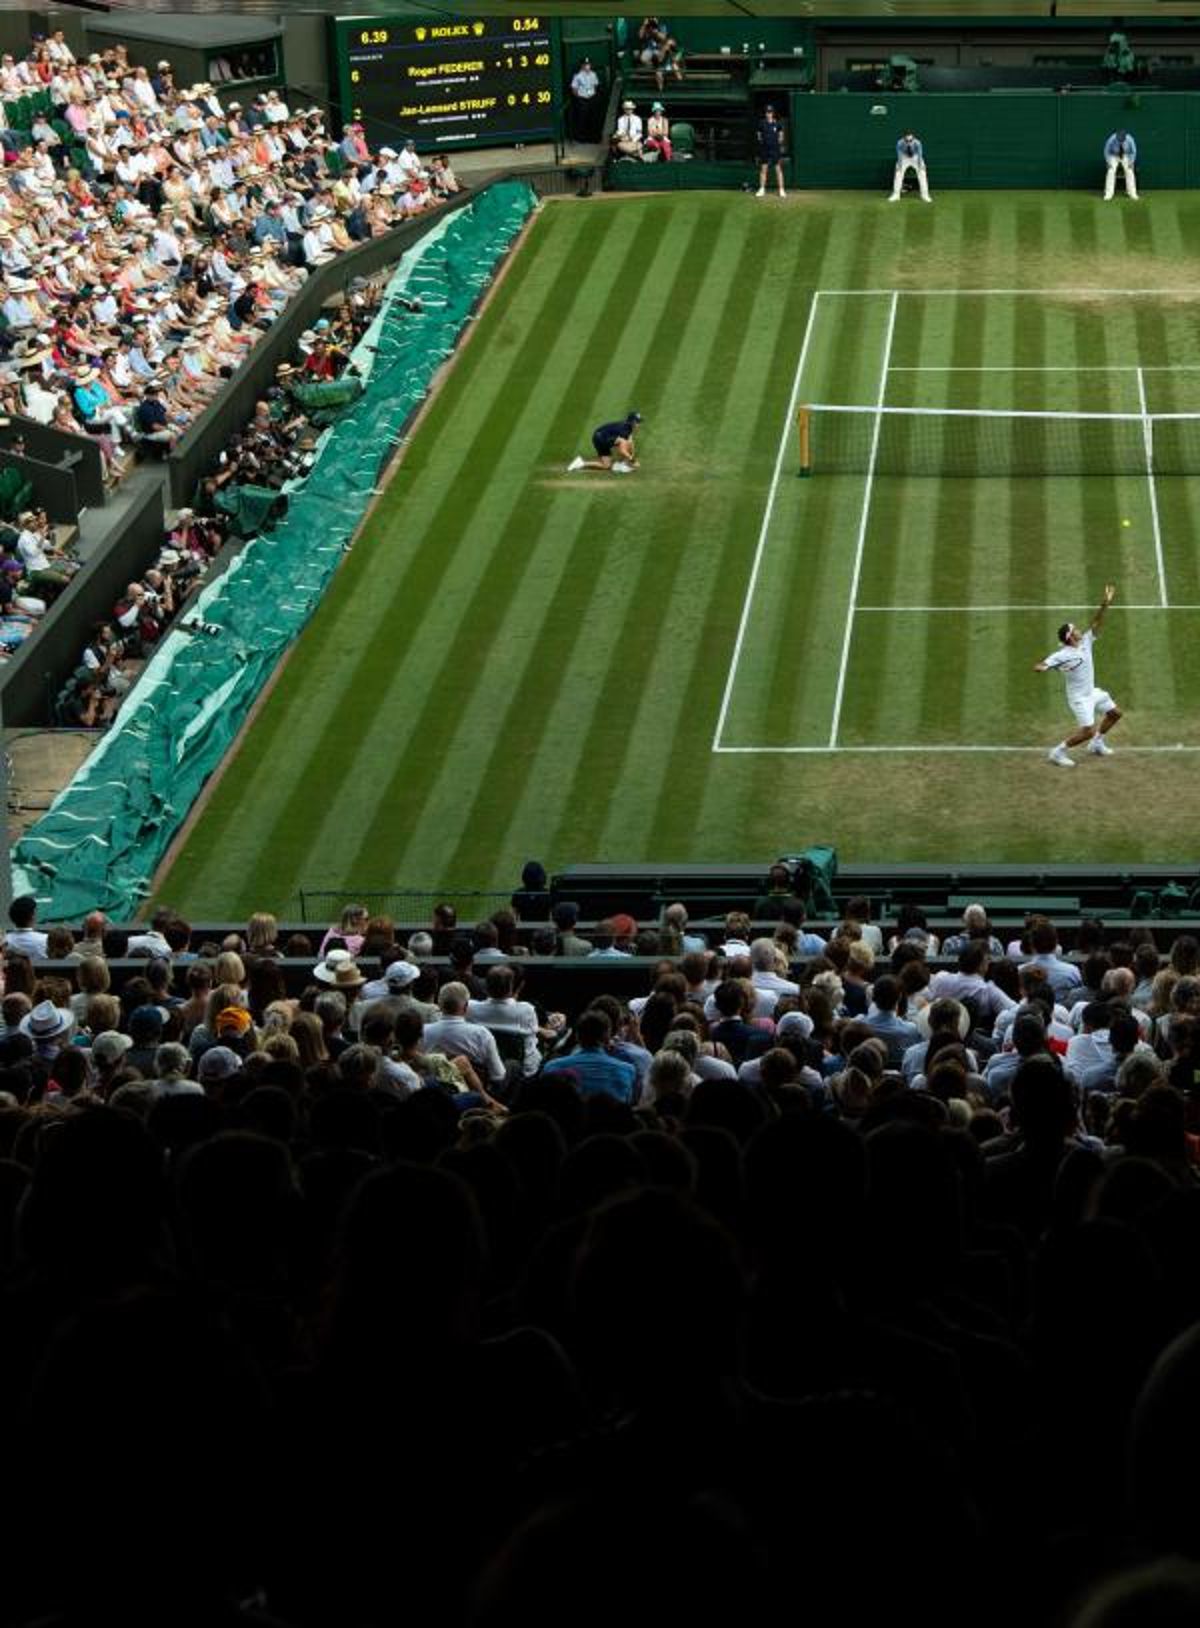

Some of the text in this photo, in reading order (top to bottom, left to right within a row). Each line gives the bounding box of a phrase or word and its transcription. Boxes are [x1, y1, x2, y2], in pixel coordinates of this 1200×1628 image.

[506, 53, 550, 69] 1 3 40
[407, 61, 484, 78] Roger FEDERER
[459, 97, 497, 111] STRUFF
[507, 90, 552, 106] 0 4 30
